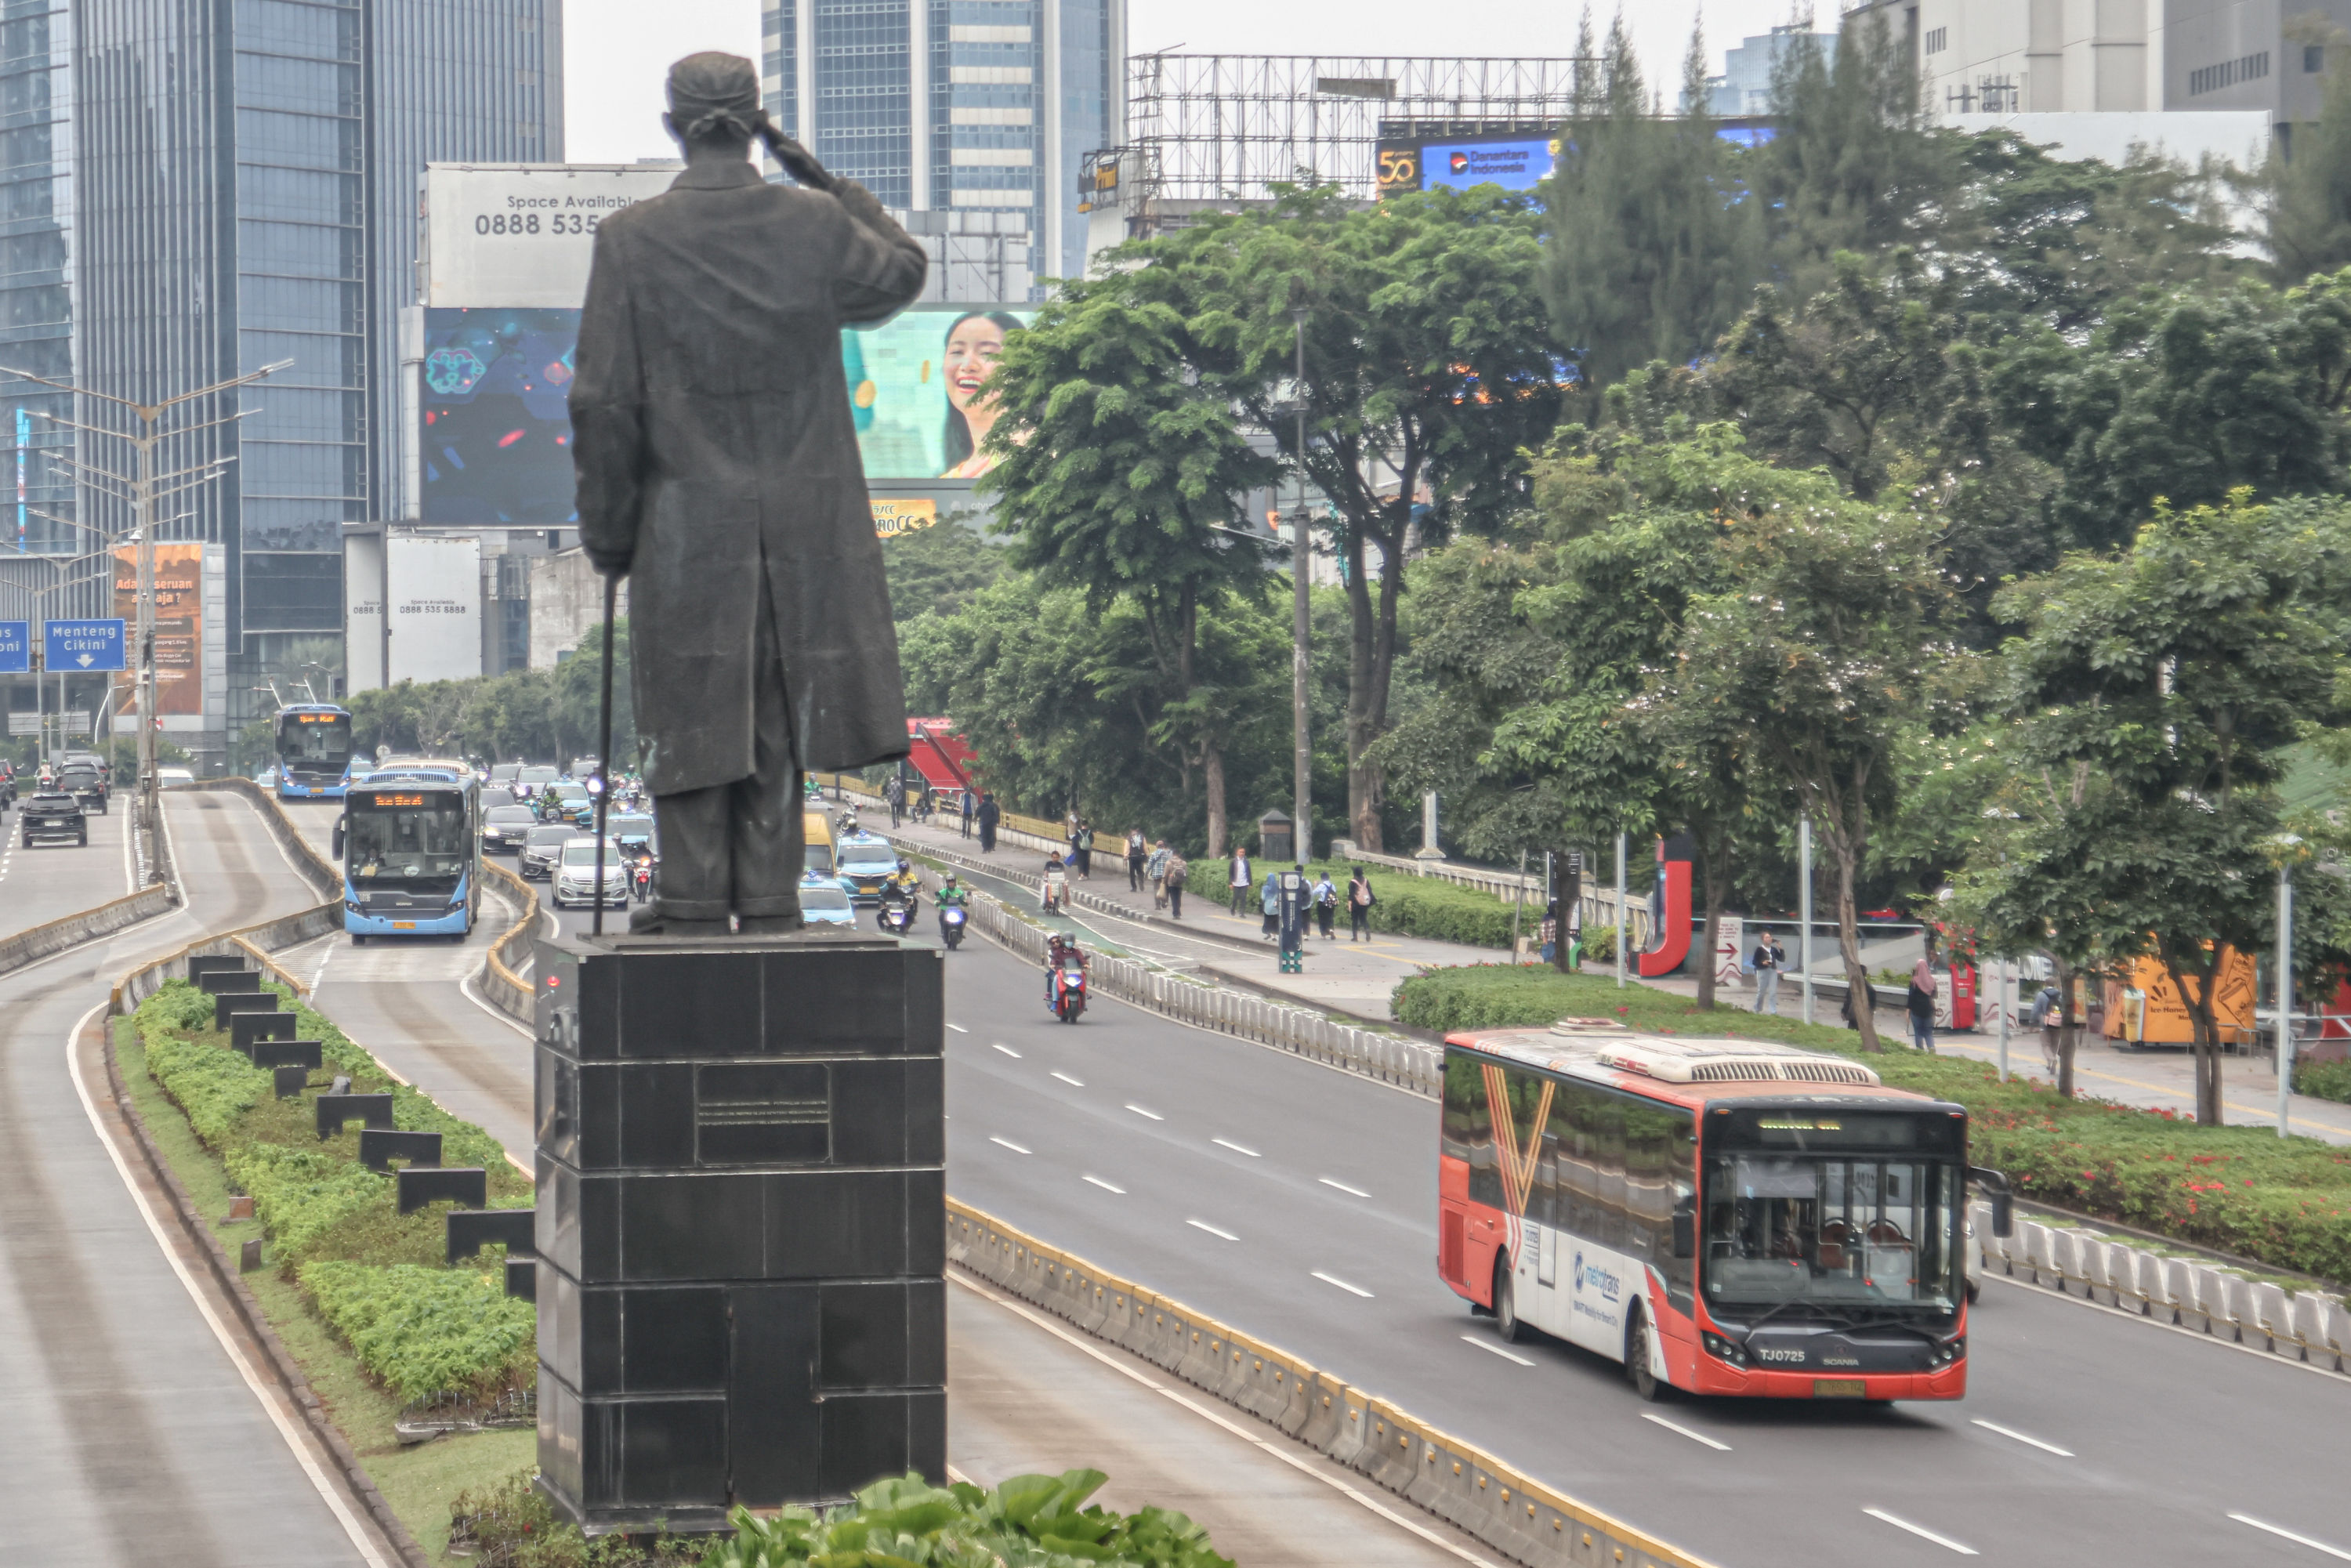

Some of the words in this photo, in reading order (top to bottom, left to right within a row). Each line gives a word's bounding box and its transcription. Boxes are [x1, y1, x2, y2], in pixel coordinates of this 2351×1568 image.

[1470, 150, 1529, 161] Danantara
[1378, 150, 1415, 183] 50
[1470, 162, 1526, 174] Indonesia
[508, 196, 559, 210] Space
[475, 214, 541, 235] 0888
[552, 214, 599, 235] 535
[116, 579, 137, 589] Ada
[155, 592, 173, 605] aja
[444, 606, 465, 614] 8888
[53, 627, 116, 639] Menteng
[64, 640, 106, 650] Cikini
[1585, 1266, 1620, 1295] metrotrans
[1759, 1349, 1806, 1362] TJ0725
